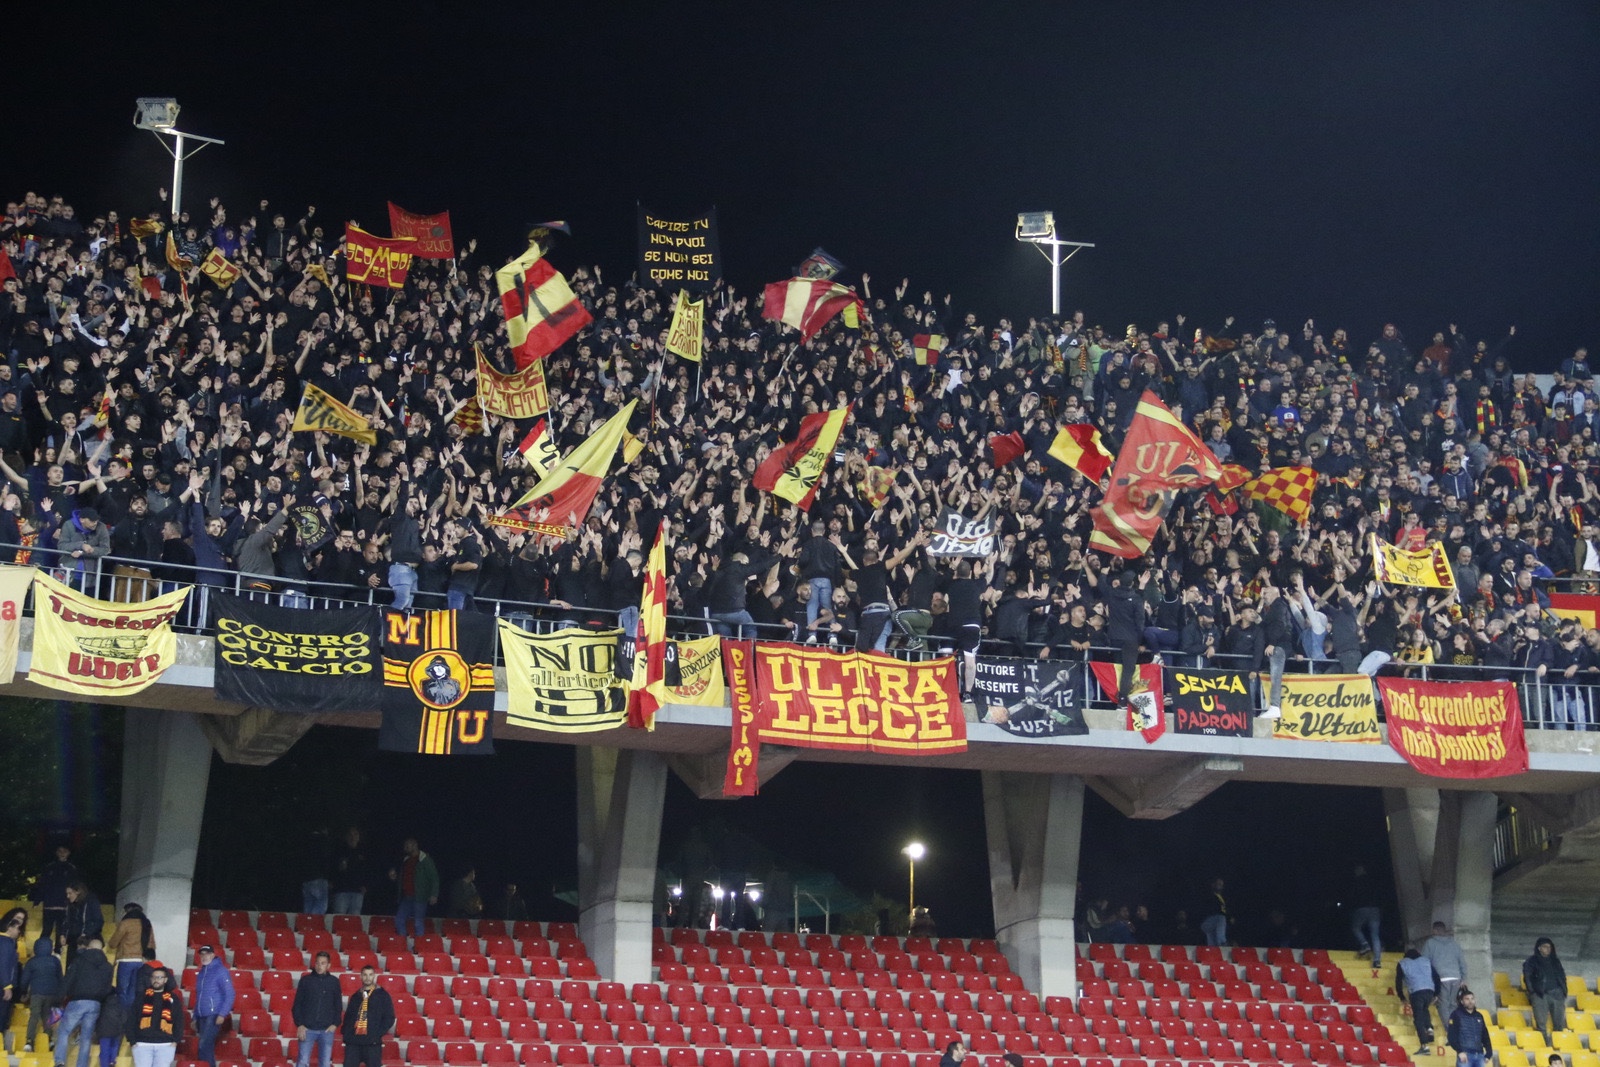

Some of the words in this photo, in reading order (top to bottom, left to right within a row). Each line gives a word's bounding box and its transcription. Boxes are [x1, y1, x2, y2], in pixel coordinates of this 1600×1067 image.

[646, 216, 689, 231] CAPIRE
[650, 233, 674, 246] NON
[644, 251, 660, 262] SE
[664, 252, 689, 264] NON
[691, 253, 714, 265] SEI
[650, 268, 683, 280] COME
[687, 270, 709, 281] NOI
[539, 523, 569, 536] LECC
[217, 617, 370, 646] CONTRO
[386, 613, 422, 646] M
[217, 633, 370, 660] QUESTO
[525, 642, 618, 674] NO
[221, 650, 373, 676] CALCIO
[680, 647, 721, 679] UTORIZZATO
[976, 662, 1016, 676] OTTORE
[674, 677, 709, 696] LECCE
[974, 678, 1020, 694] RESENTE
[1175, 673, 1247, 695] SENZA
[730, 648, 755, 786] PESSIMI
[770, 693, 953, 740] LECCE
[1386, 687, 1420, 722] mai
[1419, 689, 1507, 727] arrendersi
[456, 710, 489, 744] U
[1177, 708, 1247, 731] PADRONI
[1203, 727, 1217, 735] 1998
[1299, 711, 1378, 737] Ultras
[1401, 725, 1437, 759] mai
[1435, 725, 1507, 766] pentirsi
[1386, 986, 1395, 996] A
